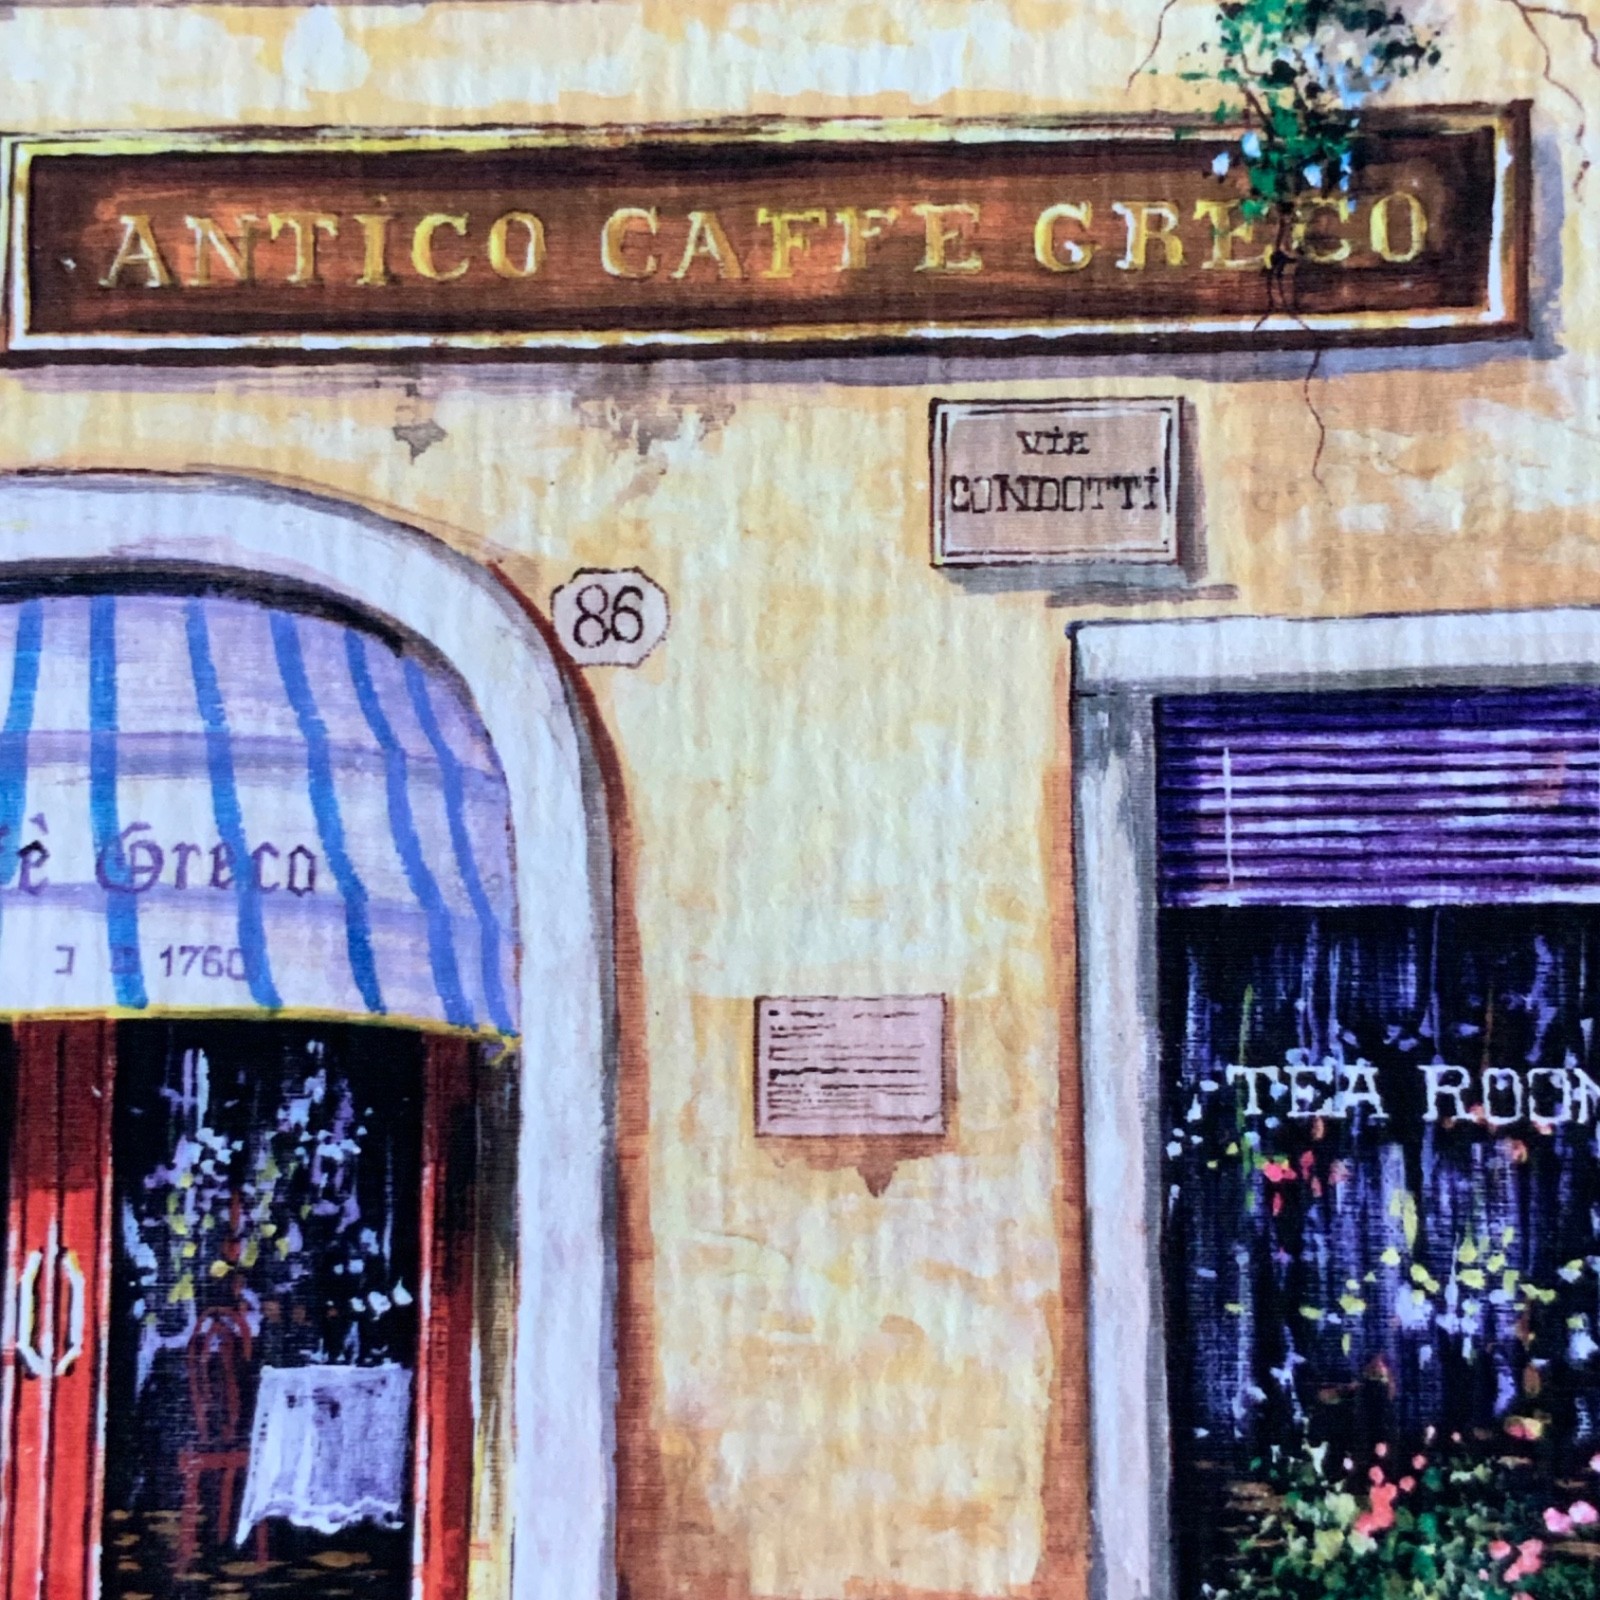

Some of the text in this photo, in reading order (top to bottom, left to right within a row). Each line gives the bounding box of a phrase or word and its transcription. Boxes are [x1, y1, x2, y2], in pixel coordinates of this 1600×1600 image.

[99, 191, 1428, 288] ANTICO CAFFE GRECO
[950, 466, 1160, 513] CONDOTTI
[573, 584, 644, 648] 86
[95, 821, 317, 898] Greco
[160, 945, 257, 981] 1760
[1226, 1062, 1389, 1119] TEA
